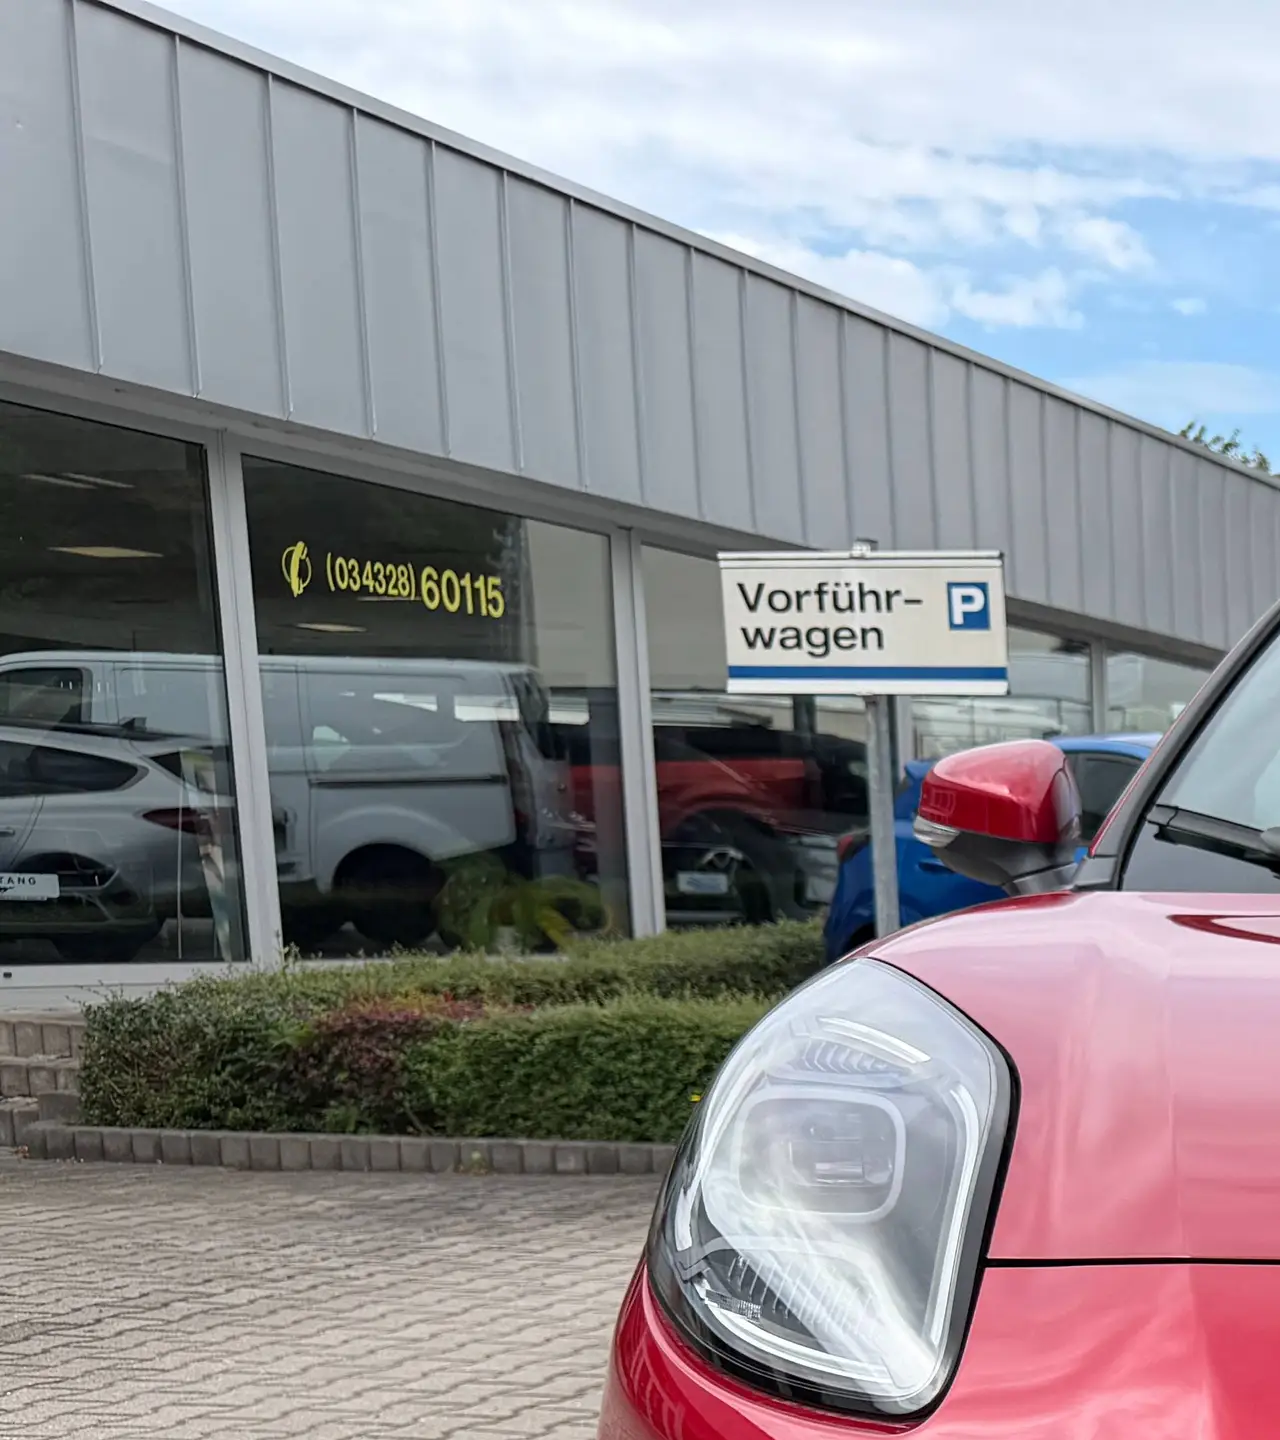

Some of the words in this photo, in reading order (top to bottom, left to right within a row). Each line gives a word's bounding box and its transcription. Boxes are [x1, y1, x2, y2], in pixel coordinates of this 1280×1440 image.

[326, 552, 416, 600] (034328)
[421, 566, 505, 618] 60115
[737, 582, 923, 613] Vorführ-
[950, 586, 985, 625] P
[740, 626, 884, 658] wagen
